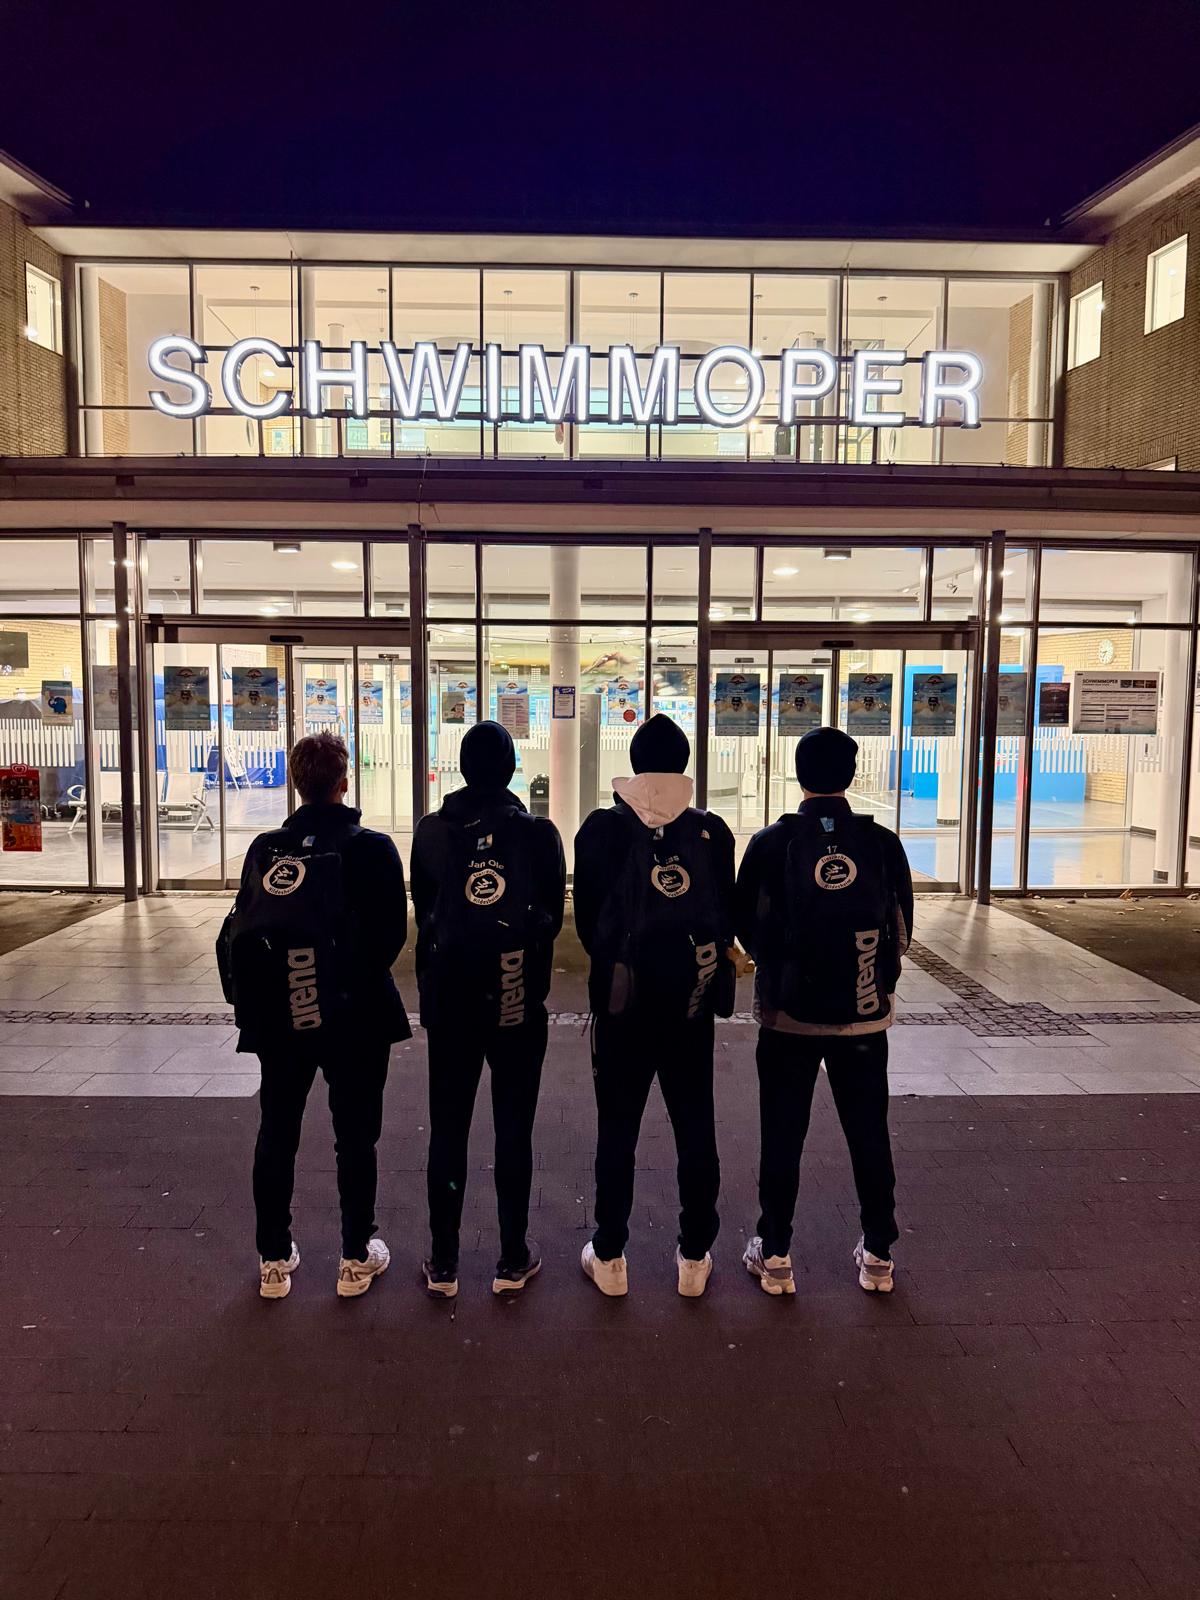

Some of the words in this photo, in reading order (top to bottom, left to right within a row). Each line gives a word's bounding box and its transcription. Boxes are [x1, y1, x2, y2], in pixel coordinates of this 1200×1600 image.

[148, 336, 983, 429] SCHWIMMOPER
[468, 860, 486, 868] Jan
[488, 859, 505, 869] Ole
[287, 947, 323, 1032] arena
[499, 949, 525, 1027] arena
[855, 929, 880, 1016] arena
